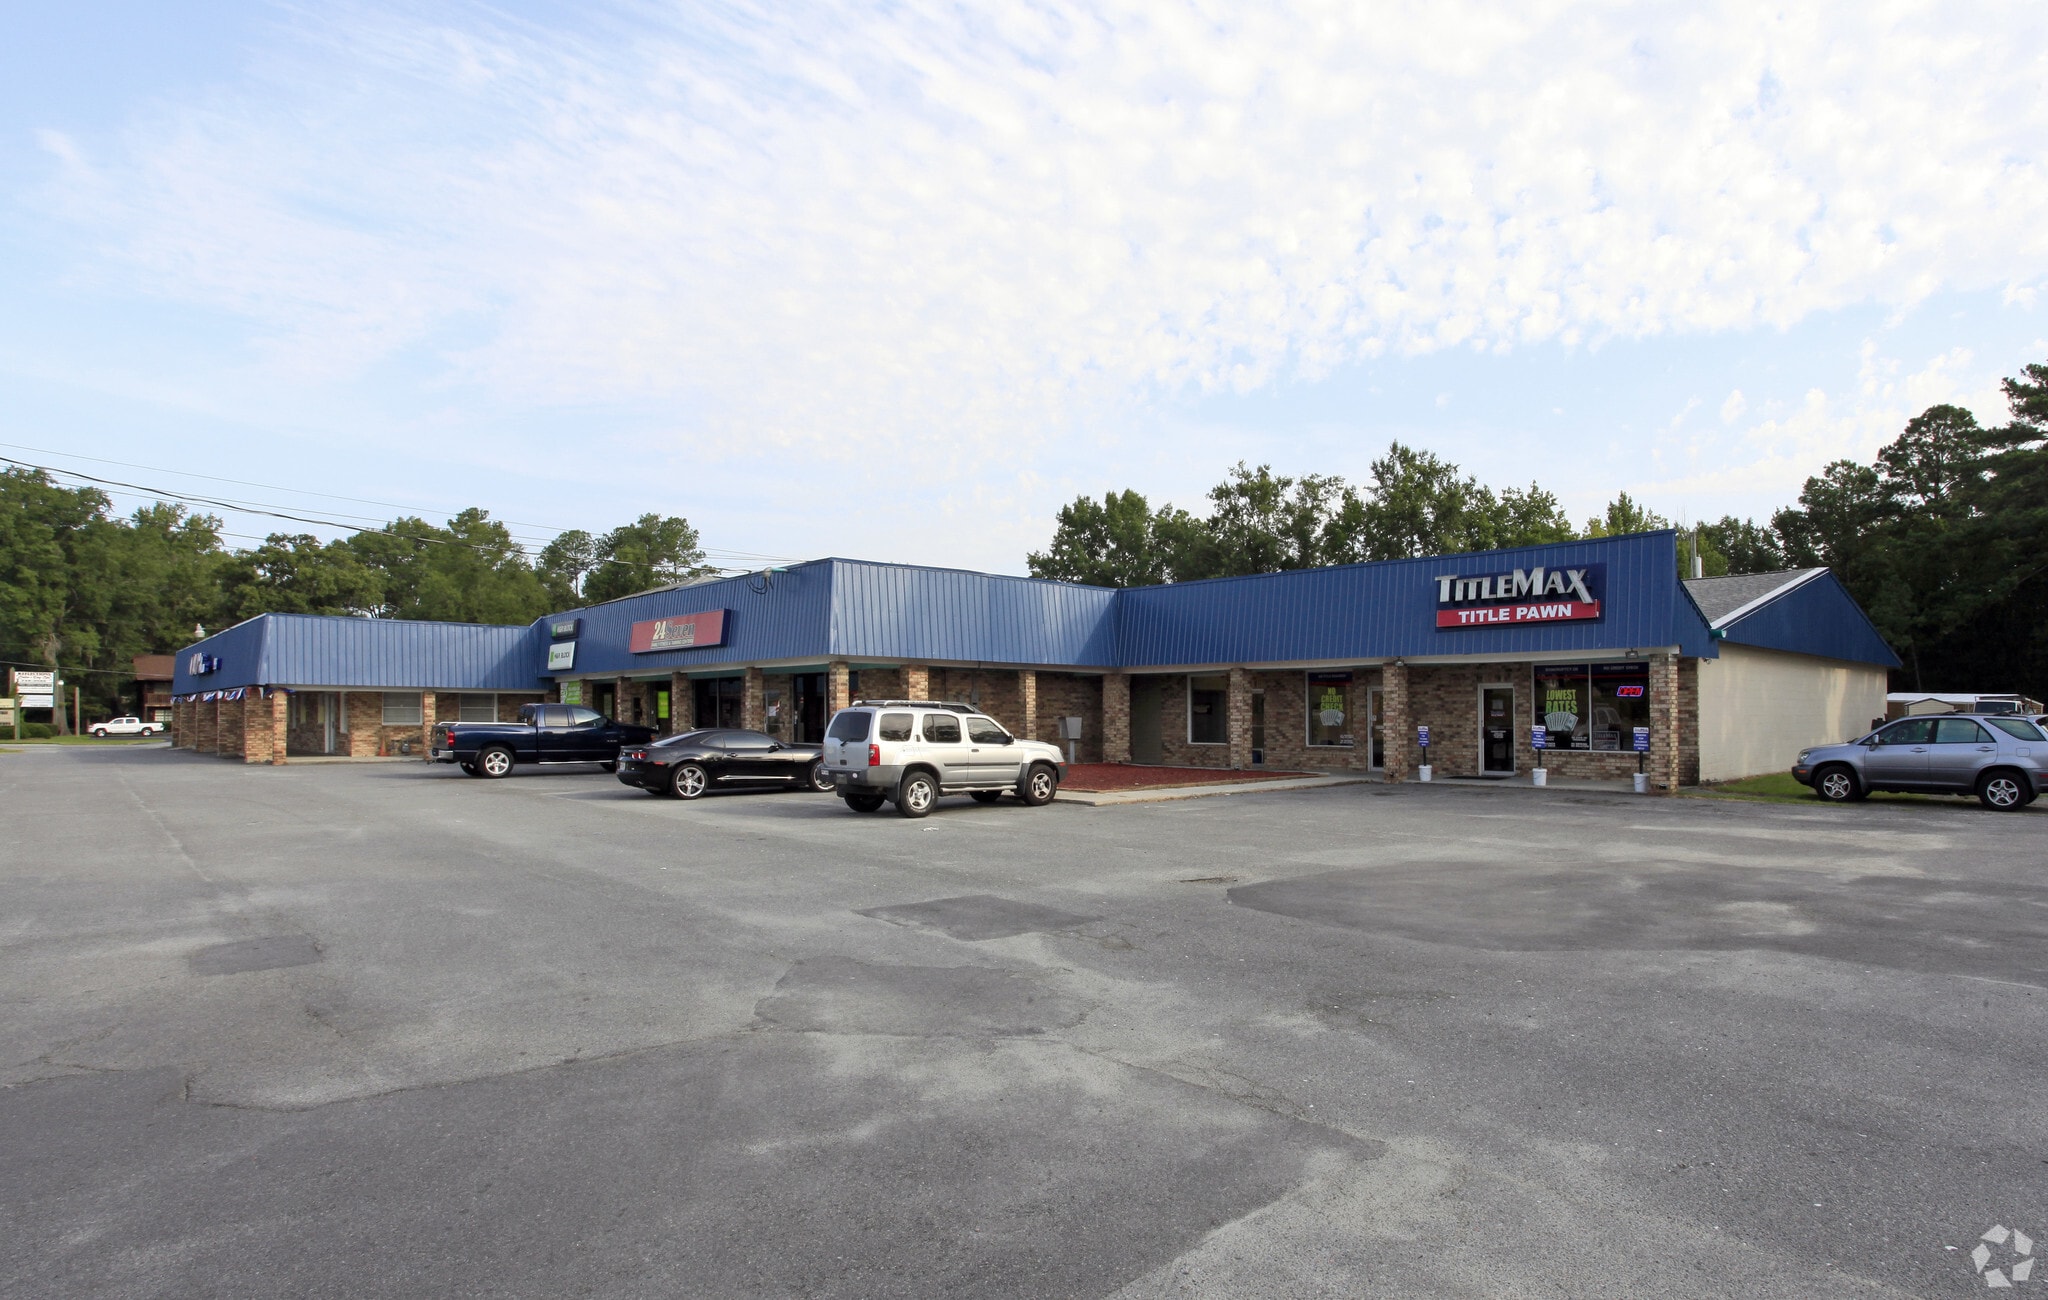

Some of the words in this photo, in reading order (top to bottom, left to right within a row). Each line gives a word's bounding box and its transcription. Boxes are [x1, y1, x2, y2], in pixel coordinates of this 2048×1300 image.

[1458, 608, 1510, 624] TITLE
[1516, 604, 1572, 620] PAWN
[1327, 687, 1337, 695] NO
[1546, 689, 1577, 700] LOWEST
[1619, 687, 1641, 696] OPEN
[1321, 695, 1343, 703] CREDIT
[1320, 703, 1344, 711] CHECK
[1545, 700, 1578, 713] RATES
